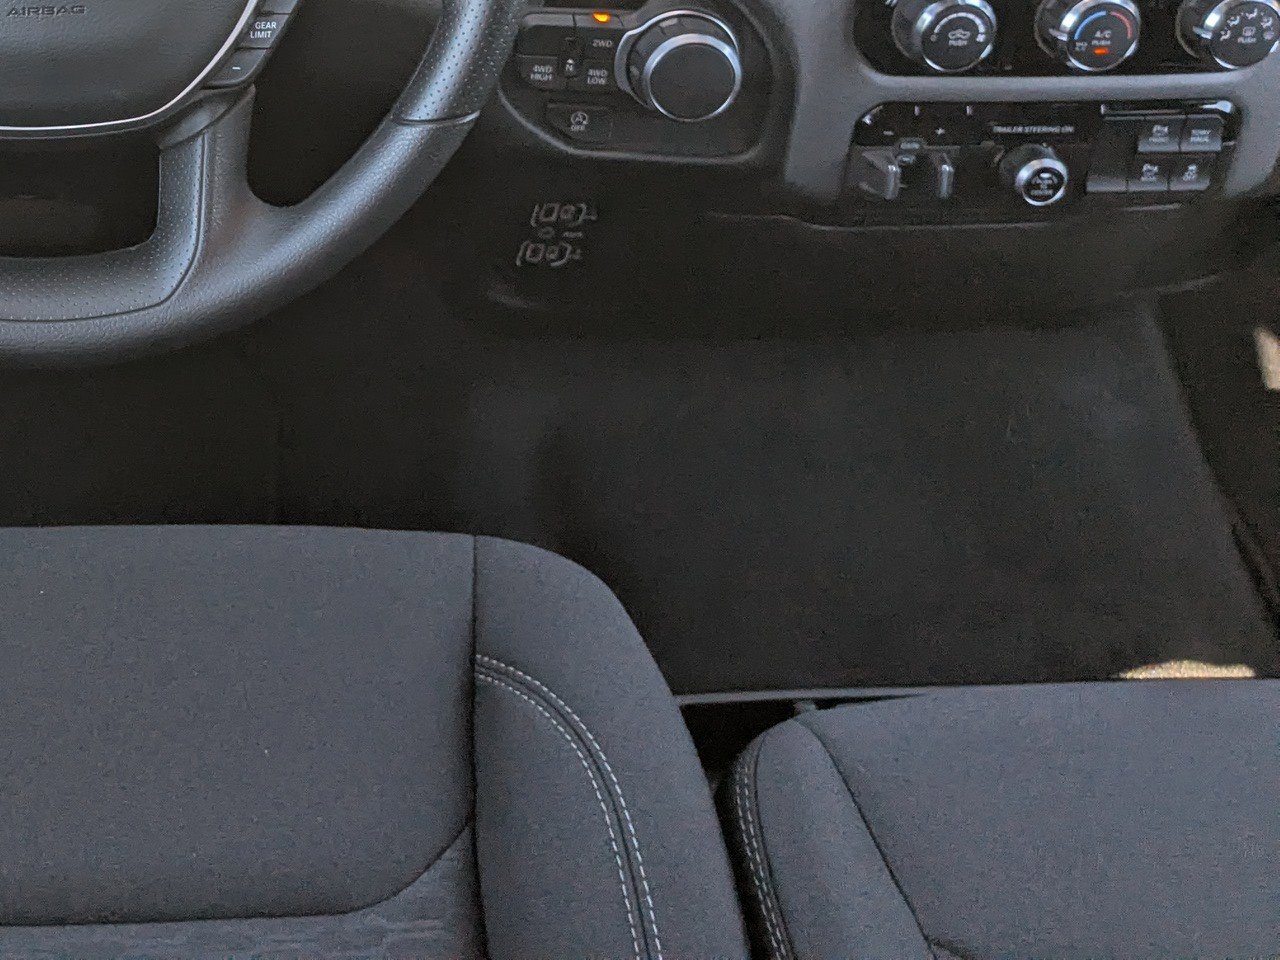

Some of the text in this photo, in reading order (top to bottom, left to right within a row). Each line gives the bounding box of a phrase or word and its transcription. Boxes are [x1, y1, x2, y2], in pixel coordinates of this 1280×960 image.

[6, 5, 87, 16] AIRBAG
[255, 21, 277, 30] GEAR
[250, 30, 272, 38] LIMIT
